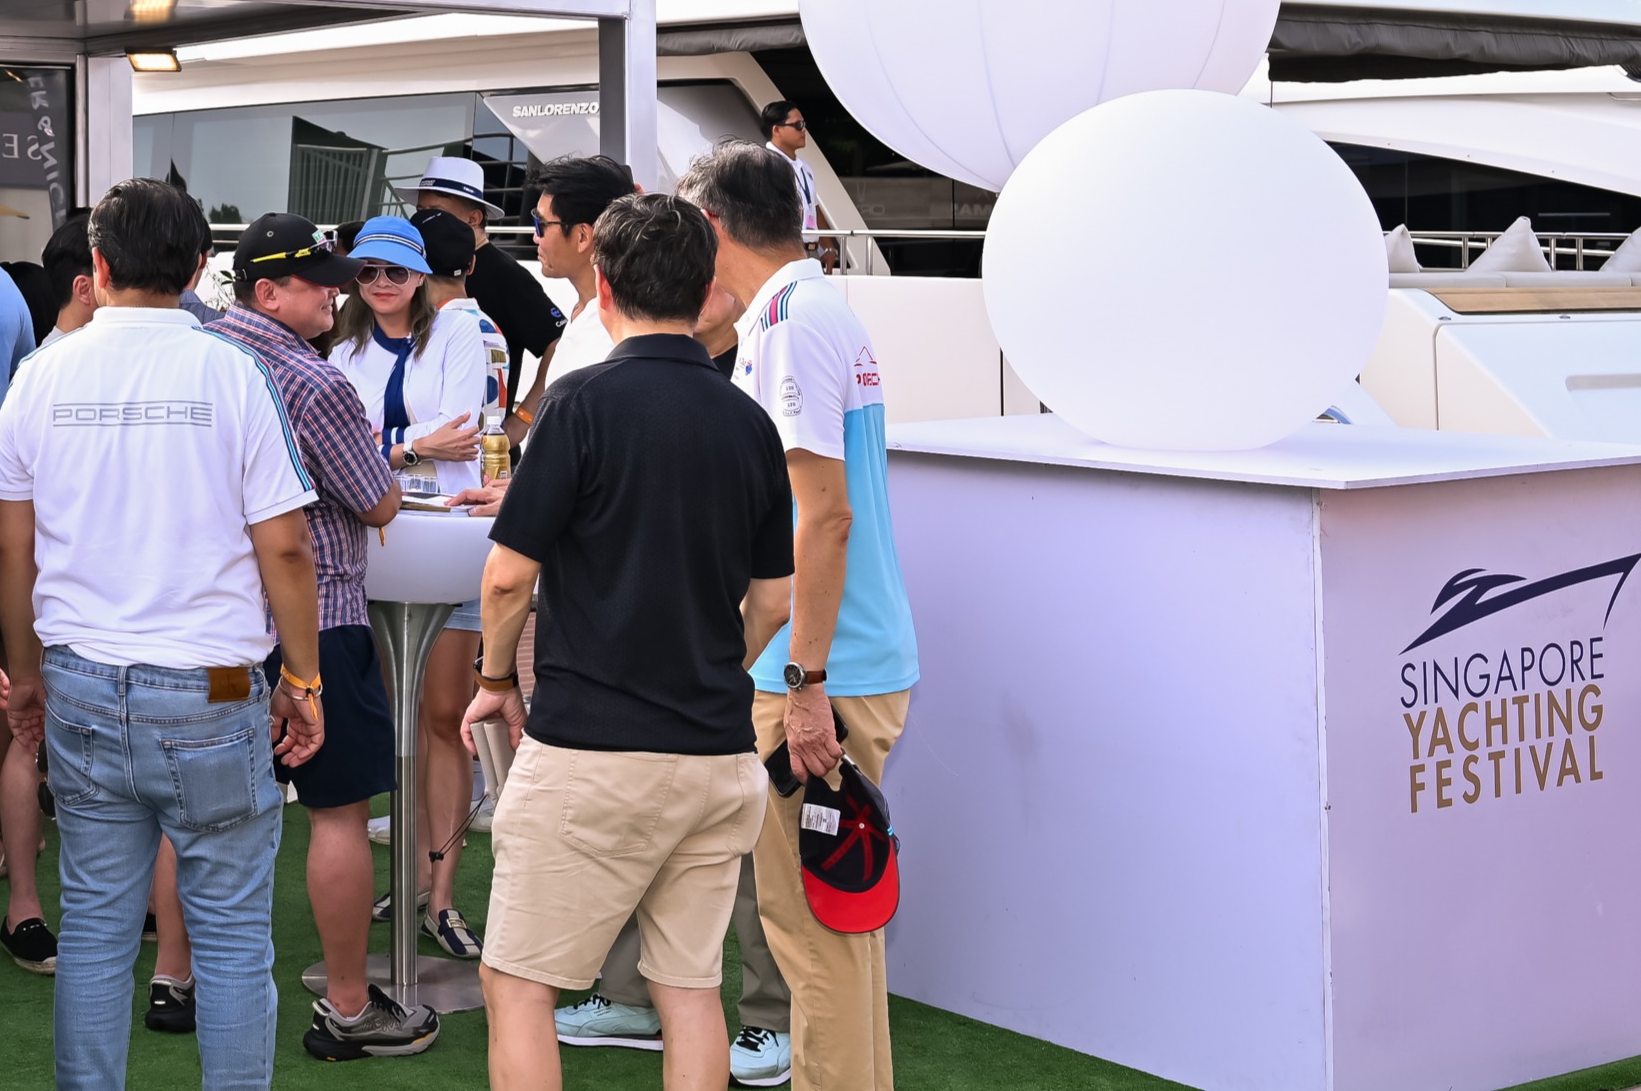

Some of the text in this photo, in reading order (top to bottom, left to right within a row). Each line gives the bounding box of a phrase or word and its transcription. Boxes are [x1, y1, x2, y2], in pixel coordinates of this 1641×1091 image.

[512, 101, 600, 117] SANLORENZO
[53, 406, 213, 422] PORSCHE
[1400, 636, 1605, 709] SINGAPORE
[1403, 684, 1604, 760] YACHTING
[1409, 735, 1604, 814] FESTIVAL
